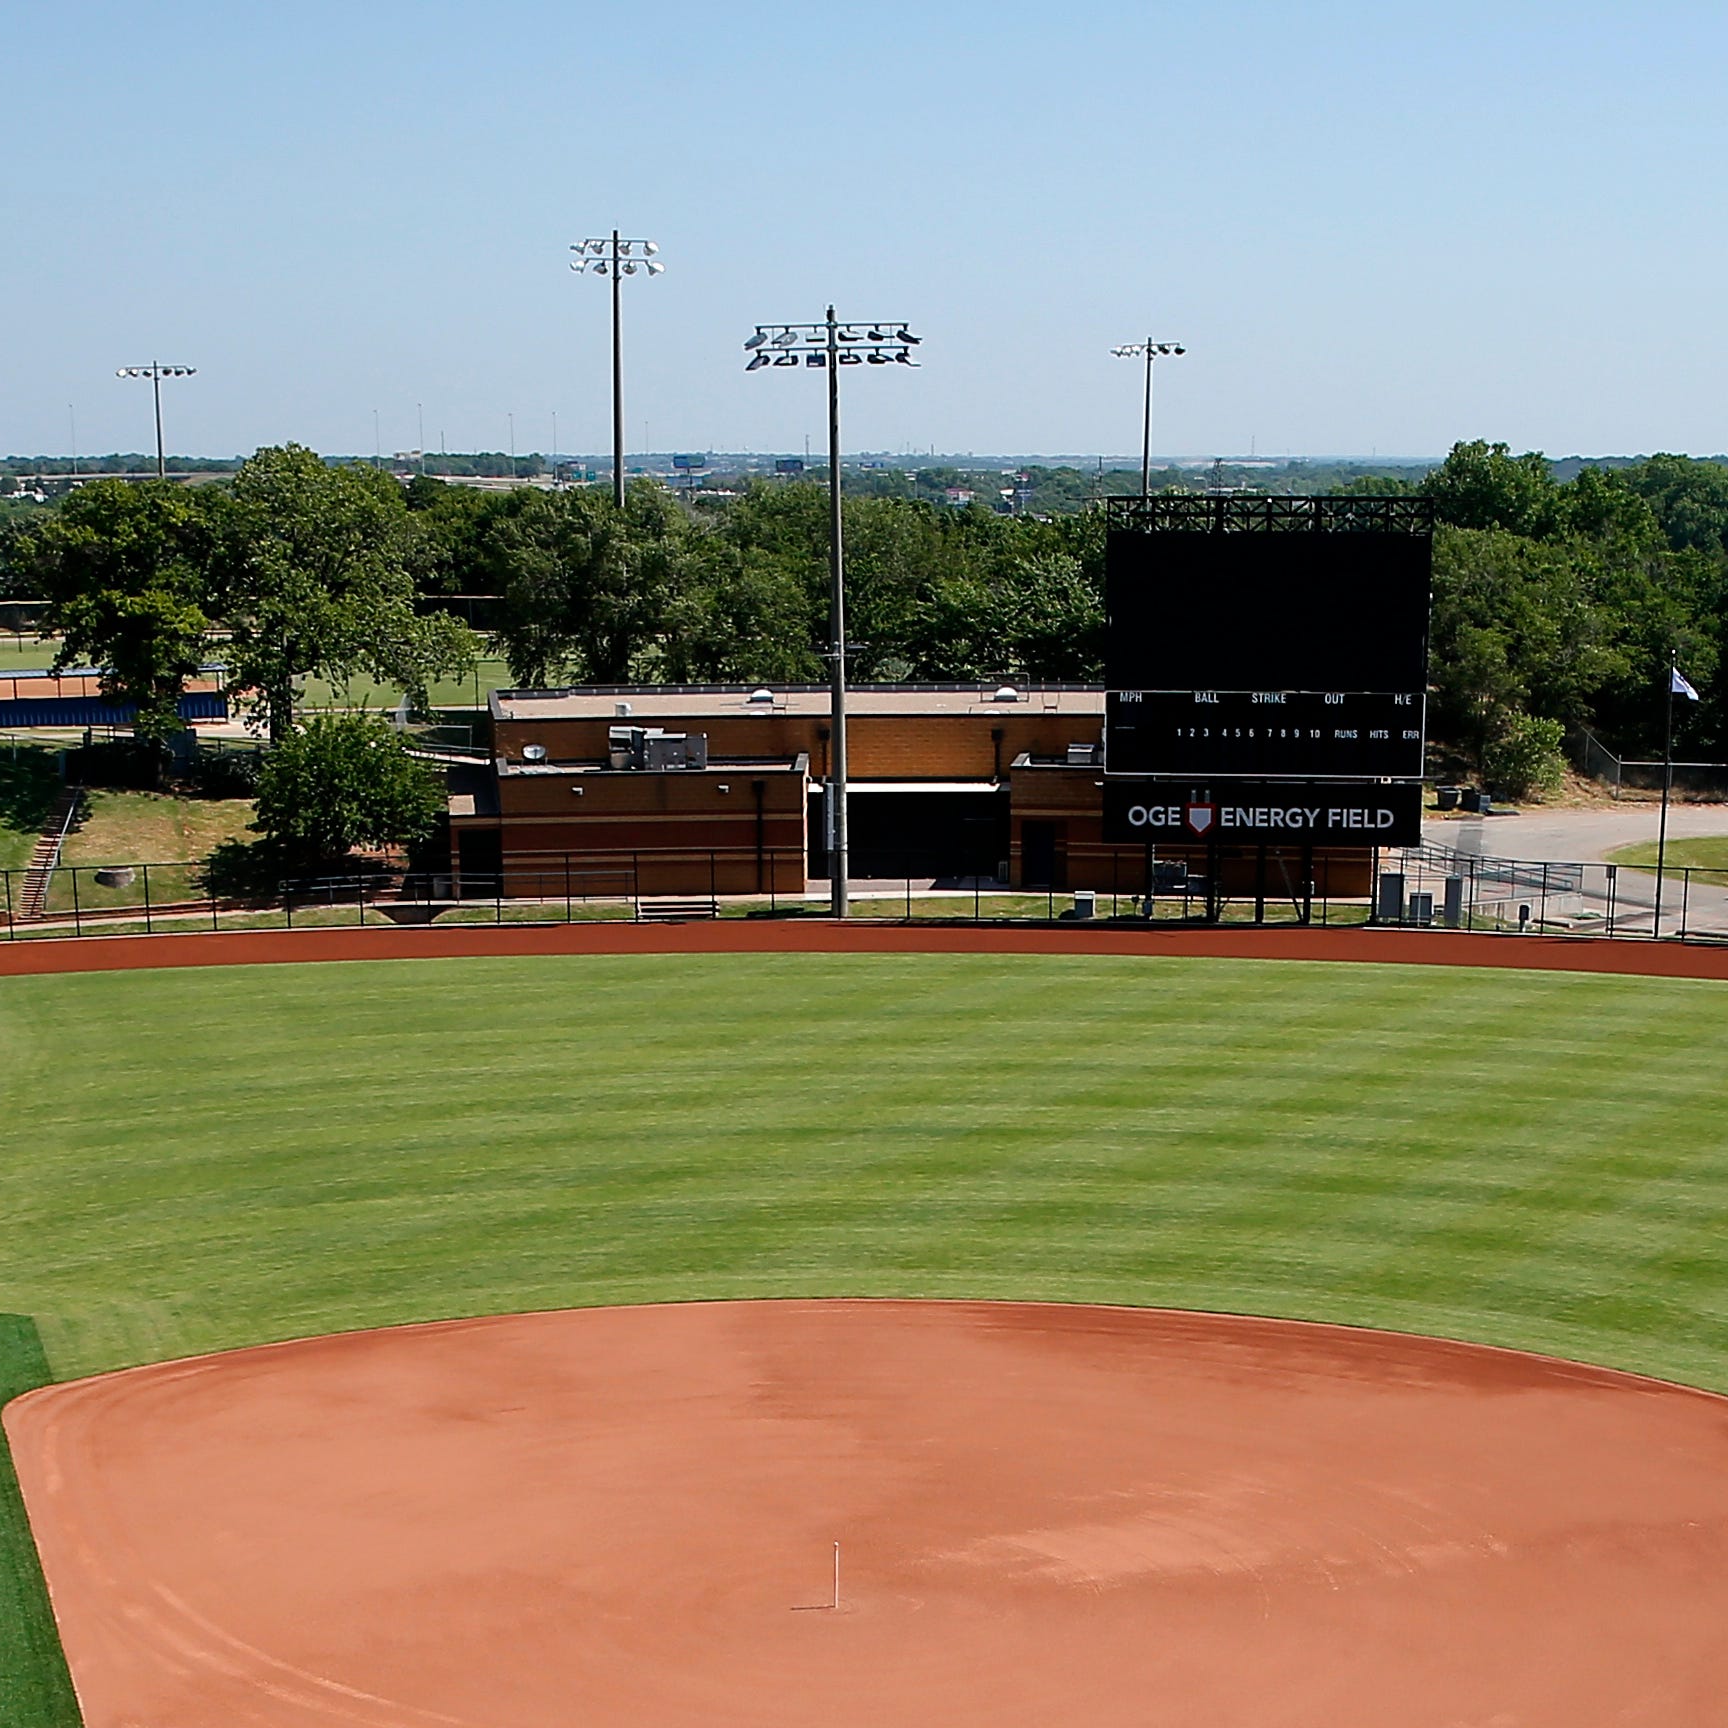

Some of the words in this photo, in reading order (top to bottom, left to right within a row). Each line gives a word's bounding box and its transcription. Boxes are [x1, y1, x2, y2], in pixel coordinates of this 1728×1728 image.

[1119, 692, 1143, 703] MPH
[1194, 692, 1220, 703] BALL
[1251, 693, 1287, 704] STRIKE
[1324, 694, 1345, 704] OUT
[1394, 694, 1412, 705] H/E
[1189, 728, 1195, 737] 2
[1203, 728, 1209, 737] 3
[1222, 728, 1227, 737] 4
[1235, 729, 1241, 738] 5
[1248, 729, 1254, 738] 6
[1267, 729, 1273, 738] 7
[1280, 729, 1286, 738] 8
[1294, 729, 1300, 738] 9
[1310, 729, 1321, 739] 10
[1334, 730, 1358, 739] RUNS
[1369, 730, 1389, 739] HITS
[1402, 730, 1419, 739] ERR
[1128, 806, 1181, 826] OGE
[1221, 807, 1320, 828] ENERGY
[1327, 808, 1394, 829] FIELD
